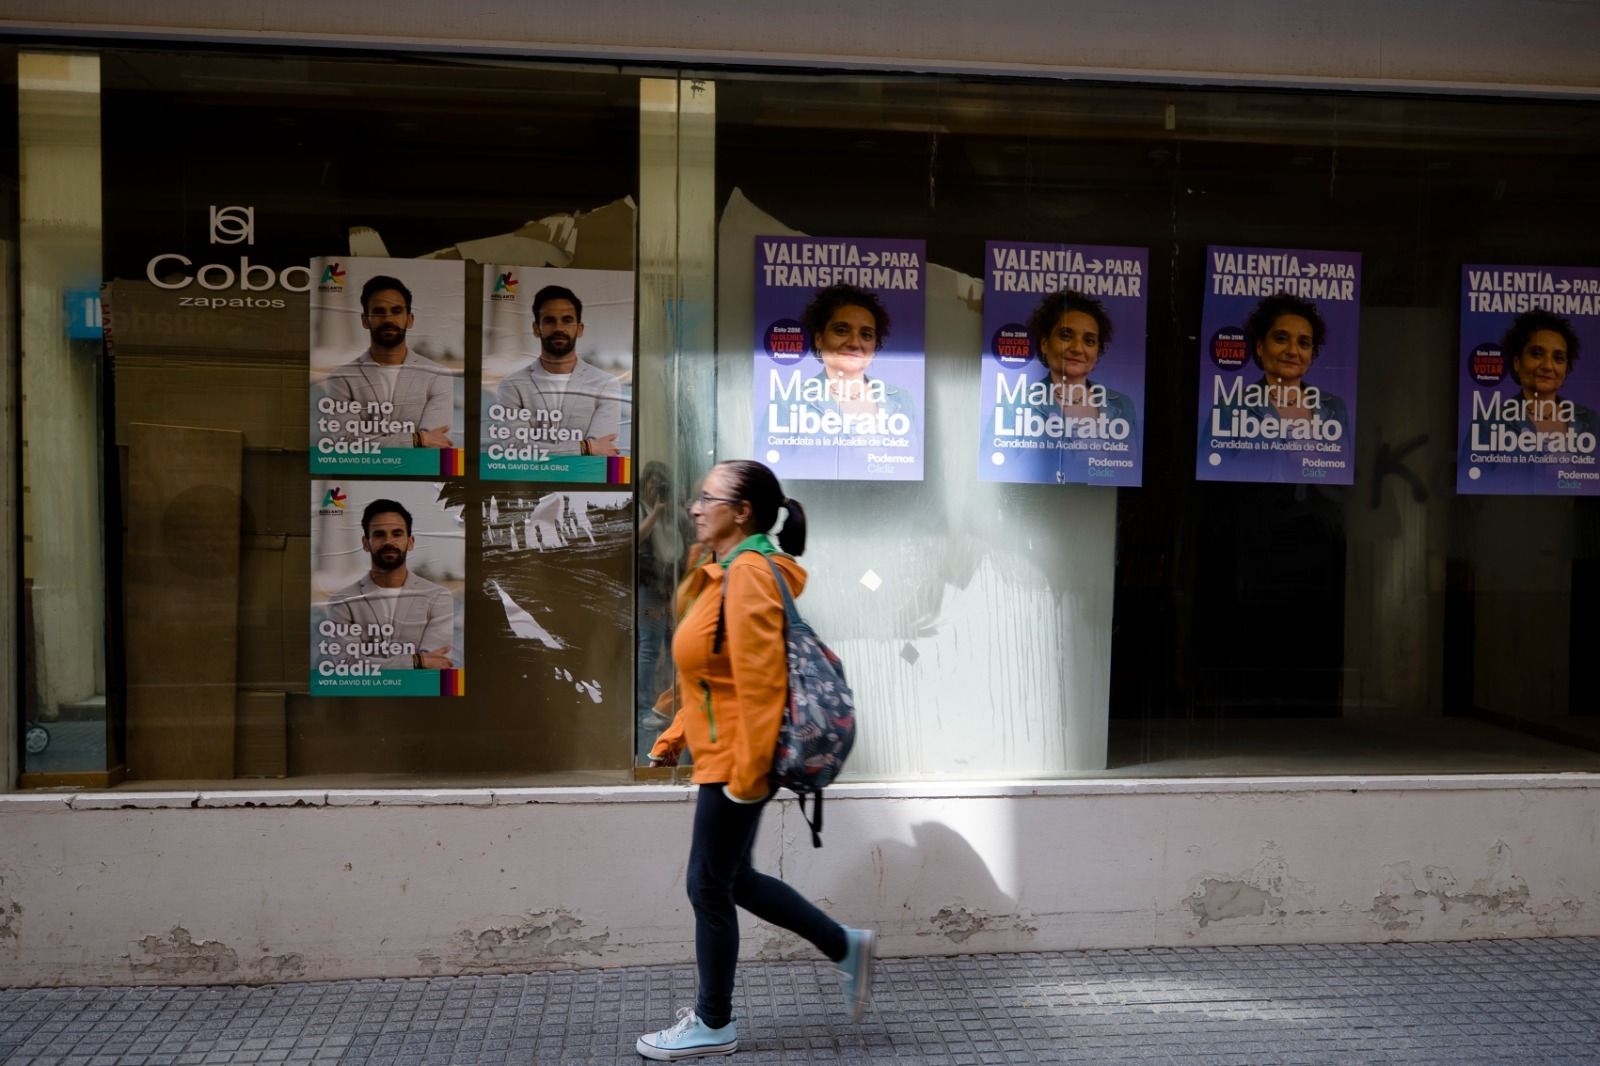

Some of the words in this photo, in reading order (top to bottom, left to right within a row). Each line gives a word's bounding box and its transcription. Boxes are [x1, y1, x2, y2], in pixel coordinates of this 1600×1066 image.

[763, 242, 862, 267] VALENTÍA
[881, 251, 919, 268] PARA
[993, 248, 1085, 273] VALENTÍA
[1105, 259, 1142, 276] PARA
[146, 253, 311, 292] Cobo
[1213, 252, 1301, 277] VALENTÍA
[1319, 263, 1355, 279] PARA
[763, 265, 919, 290] TRANSFORMAR
[993, 270, 1141, 297] TRANSFORMAR
[1468, 270, 1555, 293] VALENTÍA
[1573, 279, 1600, 294] PAR
[1213, 274, 1354, 301] TRANSFORMAR
[179, 297, 286, 309] zapatos
[770, 341, 803, 353] VOTAR
[998, 346, 1030, 357] VOTAR
[1216, 348, 1245, 359] VOTAR
[769, 368, 887, 403] Marina
[996, 372, 1107, 408] Marina
[1213, 374, 1321, 409] Marina
[318, 397, 362, 415] Que
[367, 401, 393, 414] no
[488, 404, 531, 422] Que
[537, 408, 562, 422] no
[1472, 390, 1576, 422] Marina
[318, 418, 340, 432] te
[345, 417, 415, 436] quiten
[768, 403, 911, 435] Liberato
[994, 406, 1130, 440] Liberato
[1211, 408, 1342, 441] Liberato
[488, 425, 510, 440] te
[515, 424, 583, 443] quiten
[768, 436, 813, 446] Candidata
[823, 437, 831, 446] la
[868, 437, 881, 447] de
[882, 436, 910, 447] Cádiz
[1471, 423, 1596, 453] Liberato
[318, 437, 381, 454] Cádiz
[488, 443, 549, 461] Cádiz
[993, 438, 1037, 448] Candidata
[1047, 440, 1054, 449] la
[1090, 441, 1101, 451] de
[1102, 441, 1129, 451] Cádiz
[1210, 439, 1253, 449] Candidata
[1261, 441, 1269, 450] la
[1303, 441, 1315, 451] de
[1316, 442, 1341, 453] Cádiz
[867, 453, 914, 464] Podemos
[1088, 457, 1134, 467] Podemos
[1302, 458, 1346, 469] Podemos
[1470, 453, 1512, 463] Candidata
[1519, 454, 1527, 464] la
[1558, 455, 1570, 464] de
[1571, 455, 1596, 465] Cádiz
[1372, 434, 1428, 509] K
[1558, 470, 1600, 480] Podemos
[318, 620, 362, 637] Que
[368, 623, 394, 636] no
[319, 640, 341, 655] te
[346, 638, 416, 658] quiten
[318, 659, 382, 676] Cádiz
